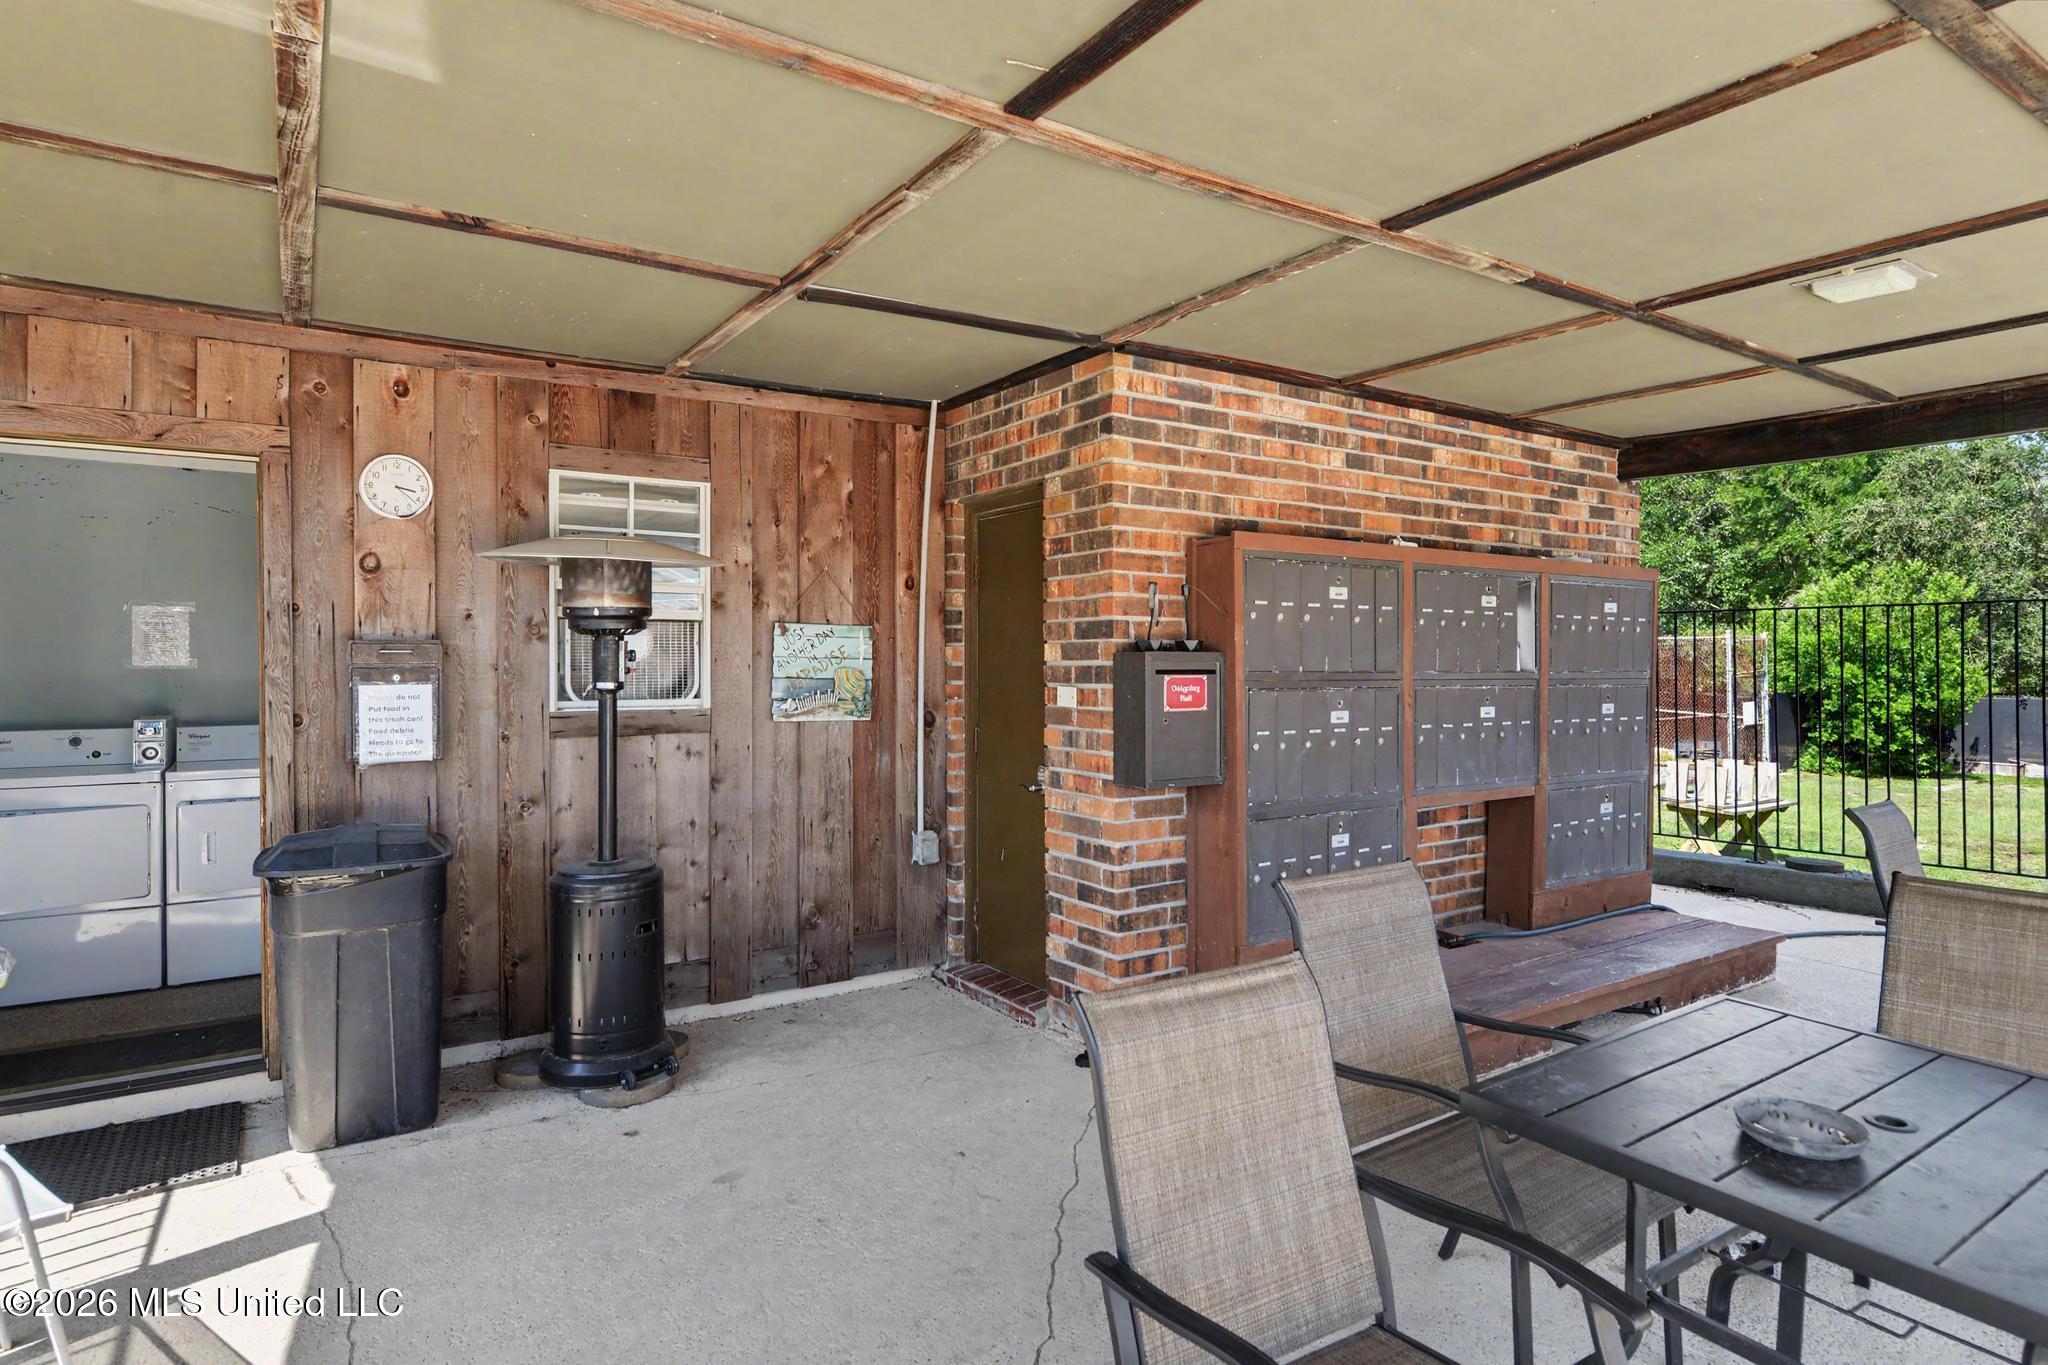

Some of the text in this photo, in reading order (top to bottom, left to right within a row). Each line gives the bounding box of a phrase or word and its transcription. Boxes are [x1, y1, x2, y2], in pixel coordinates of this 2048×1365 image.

[372, 471, 380, 479] 10
[416, 474, 421, 482] 2
[783, 626, 805, 651] JUST
[777, 627, 836, 672] ANOTHER DAY
[808, 653, 819, 664] IN
[786, 644, 847, 691] PARADISE
